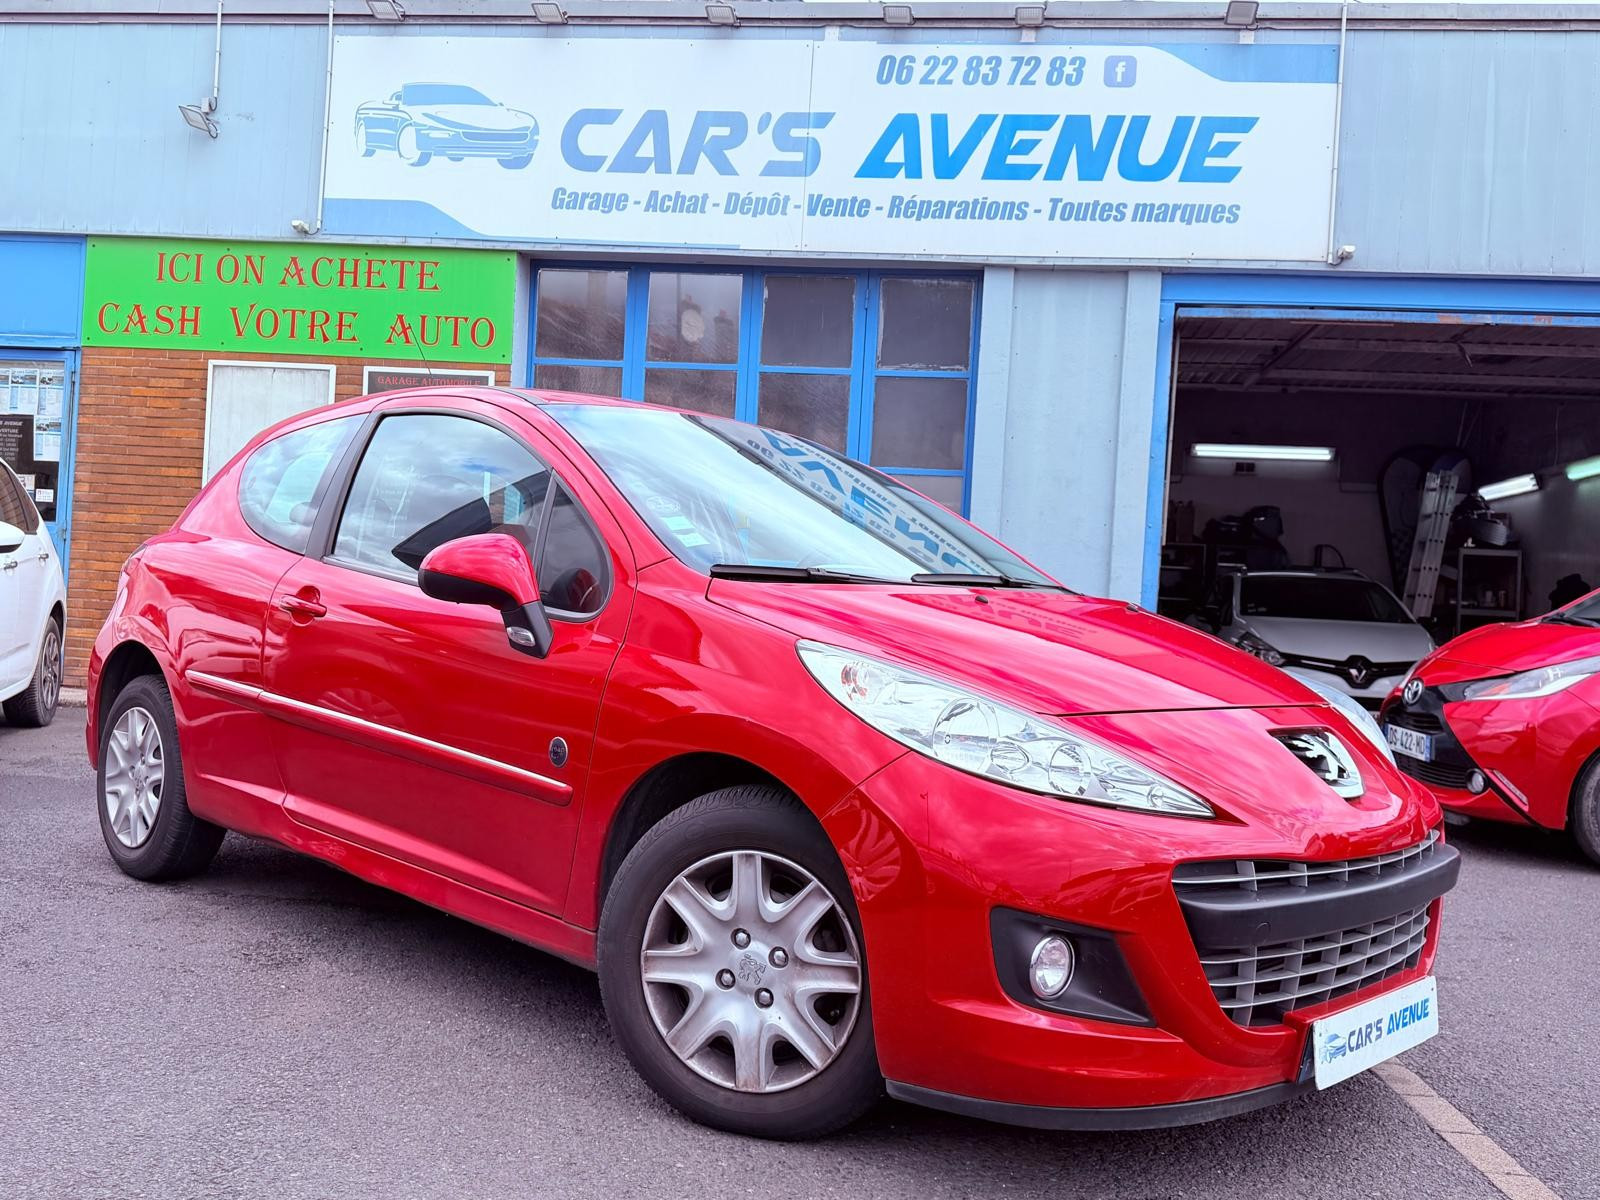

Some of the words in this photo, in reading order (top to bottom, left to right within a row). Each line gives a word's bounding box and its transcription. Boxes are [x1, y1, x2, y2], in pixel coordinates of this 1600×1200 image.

[876, 54, 915, 86] 06
[919, 55, 958, 86] 22
[962, 55, 1001, 86] 83
[1006, 55, 1041, 86] 72
[1045, 55, 1086, 86] 83
[560, 108, 836, 178] CAR'S
[853, 113, 1260, 183] AVENUE
[551, 187, 629, 214] Garage
[644, 190, 709, 214] Achat
[724, 192, 791, 217] Dépôt
[806, 193, 870, 218] Vente
[887, 194, 1029, 222] Réparations
[1048, 197, 1127, 223] Toutes
[1131, 202, 1241, 226] marques
[156, 252, 203, 283] ICI
[216, 253, 266, 286] ON
[279, 256, 441, 291] ACHETE
[98, 302, 201, 336] CASH
[229, 302, 359, 344] VOTRE
[385, 313, 496, 348] AUTO
[377, 375, 419, 385] GARAGE
[421, 377, 481, 386] AUTOMOBILE
[1347, 1017, 1383, 1053] CAR'S
[1386, 998, 1430, 1035] AVENUE
